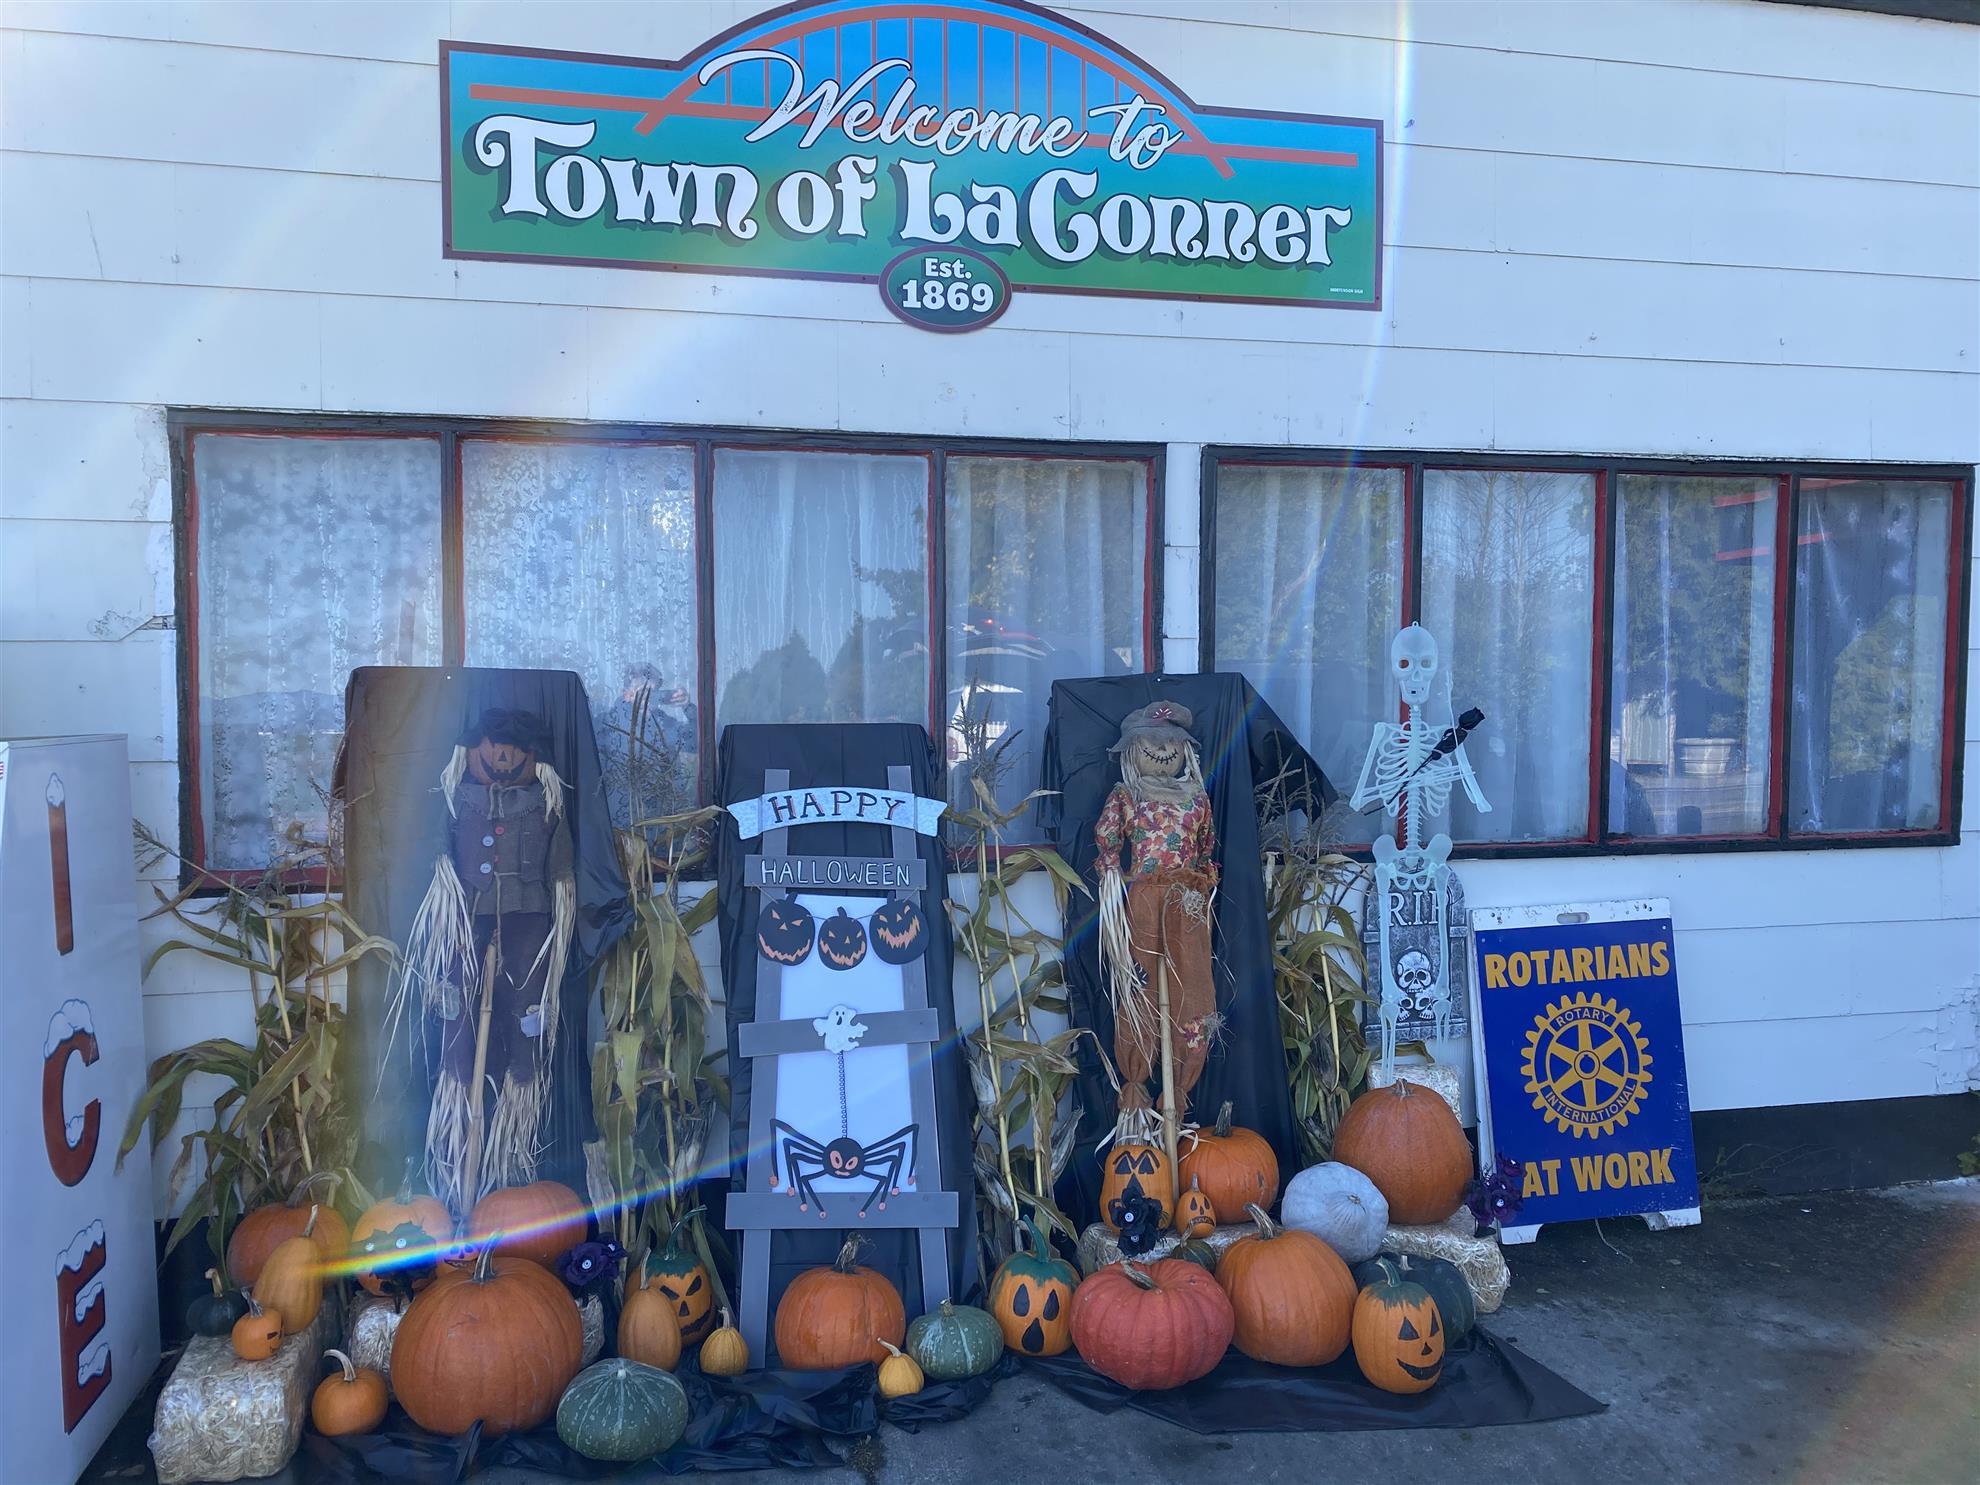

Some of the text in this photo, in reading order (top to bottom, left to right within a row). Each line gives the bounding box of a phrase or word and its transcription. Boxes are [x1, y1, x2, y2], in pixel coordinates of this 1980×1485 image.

[699, 48, 1184, 169] Welcome to
[474, 113, 759, 240] Town
[777, 154, 878, 238] of
[924, 257, 972, 279] Est.
[901, 279, 994, 313] 1869
[767, 789, 906, 824] HAPPY
[760, 859, 911, 887] HALLOWEEN
[1484, 941, 1671, 989] ROTARIANS
[1555, 1007, 1611, 1028] ROTARY
[42, 772, 113, 1436] ICE
[1544, 1083, 1637, 1123] INTERNATIONAL
[1521, 1147, 1676, 1199] AT WORK
